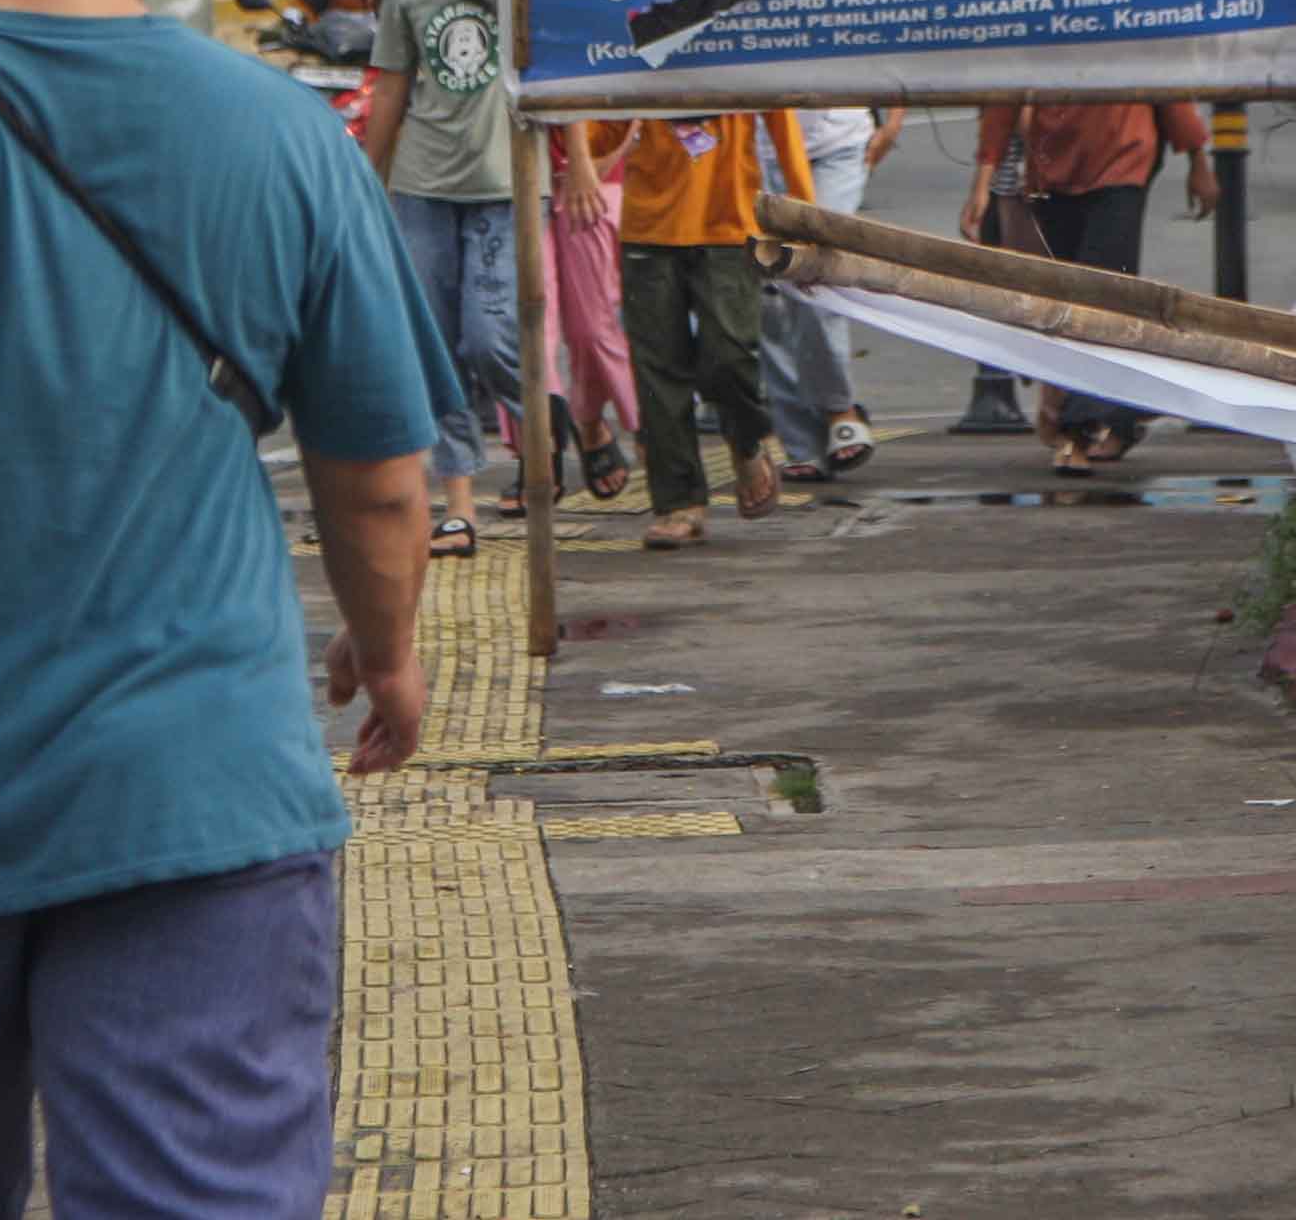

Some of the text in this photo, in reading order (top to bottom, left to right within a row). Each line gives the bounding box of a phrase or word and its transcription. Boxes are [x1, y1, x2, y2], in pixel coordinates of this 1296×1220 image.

[678, 32, 735, 56] uren
[740, 33, 812, 53] Sawit
[832, 27, 889, 47] Kec.
[894, 19, 1027, 44] Jatinegara
[1050, 13, 1106, 36] Kec.
[1113, 0, 1206, 30] Kramat
[712, 14, 803, 35] DAERAH
[806, 8, 929, 29] PEMILIHAN
